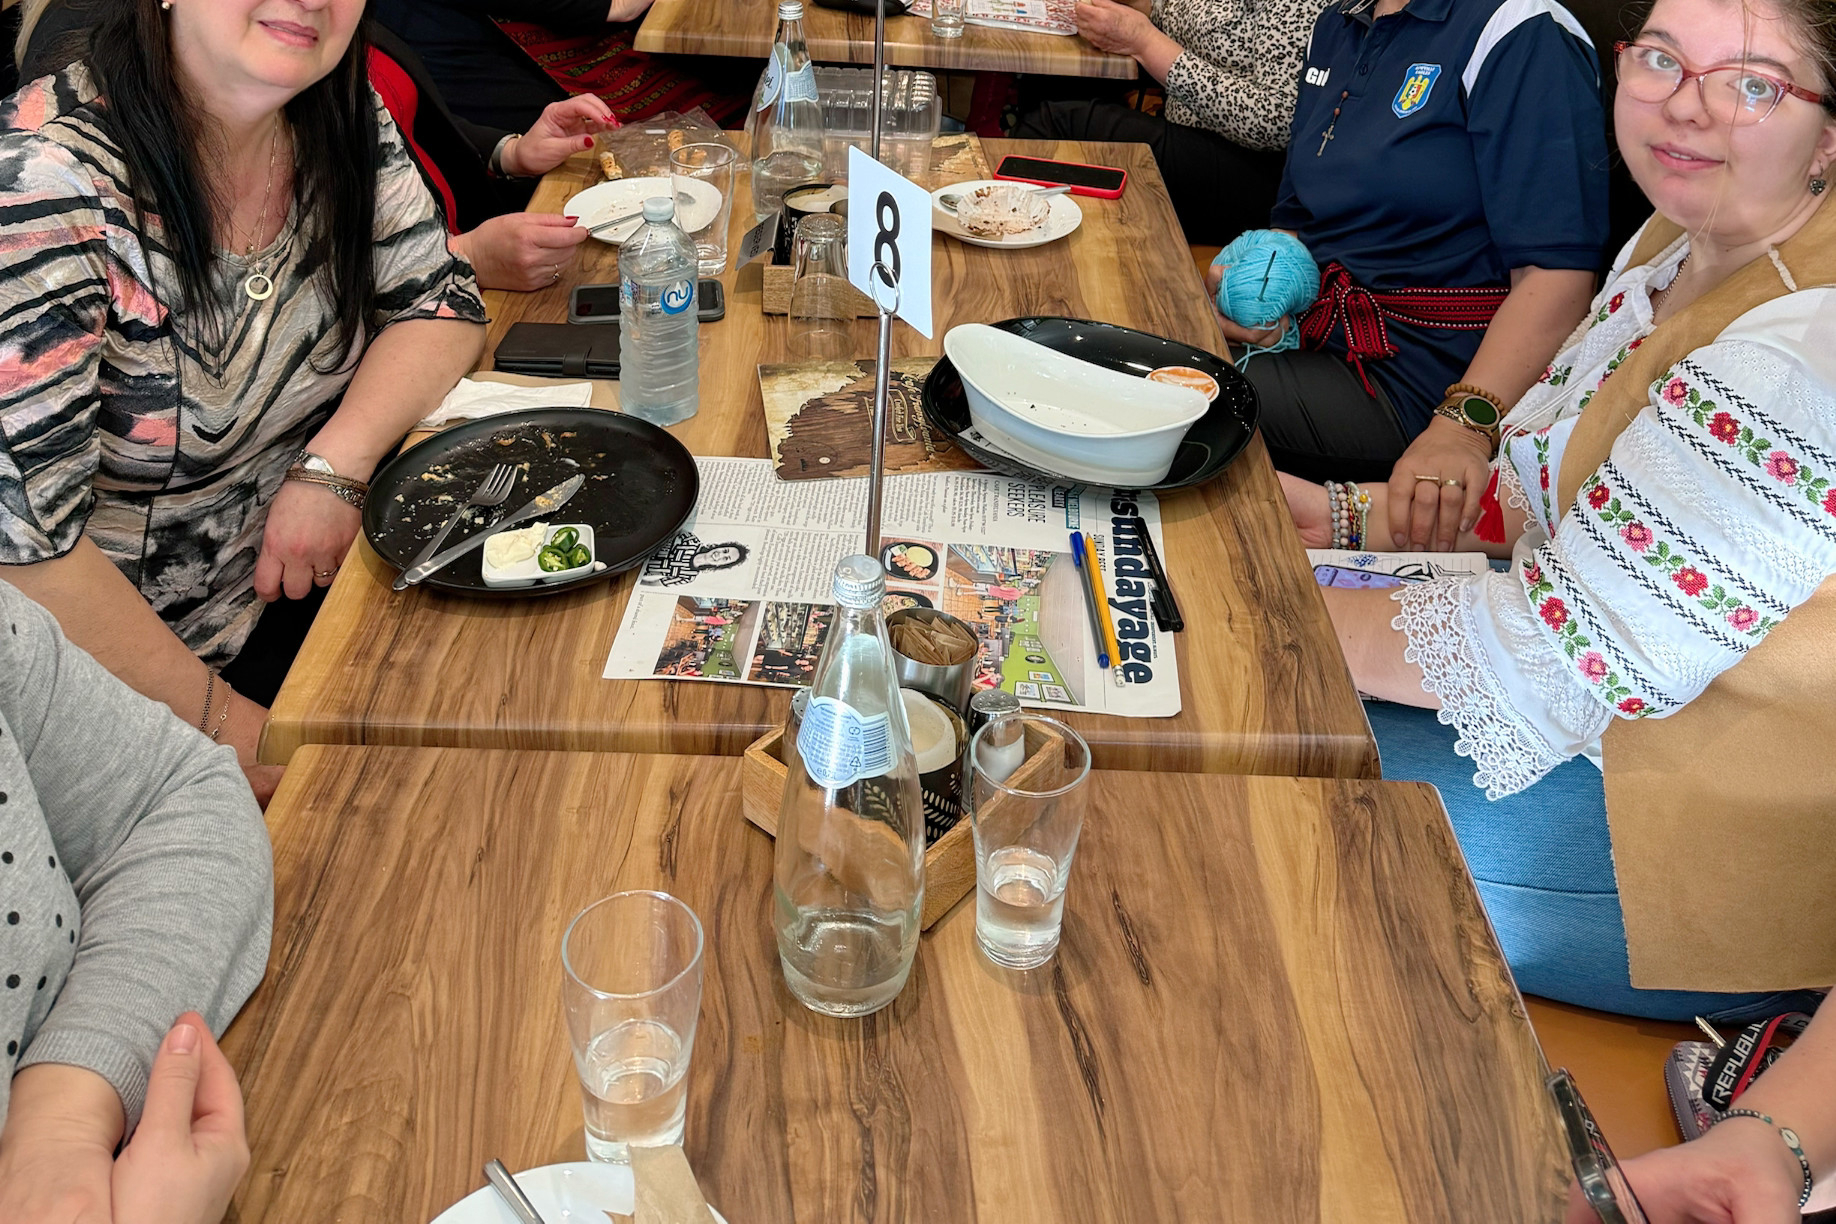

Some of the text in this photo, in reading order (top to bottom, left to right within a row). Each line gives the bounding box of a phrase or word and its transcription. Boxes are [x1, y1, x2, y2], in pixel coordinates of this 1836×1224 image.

[874, 191, 900, 288] 8
[1007, 482, 1025, 518] SEEKERS
[1027, 484, 1046, 524] PLEASURE
[1107, 489, 1153, 684] sundayage
